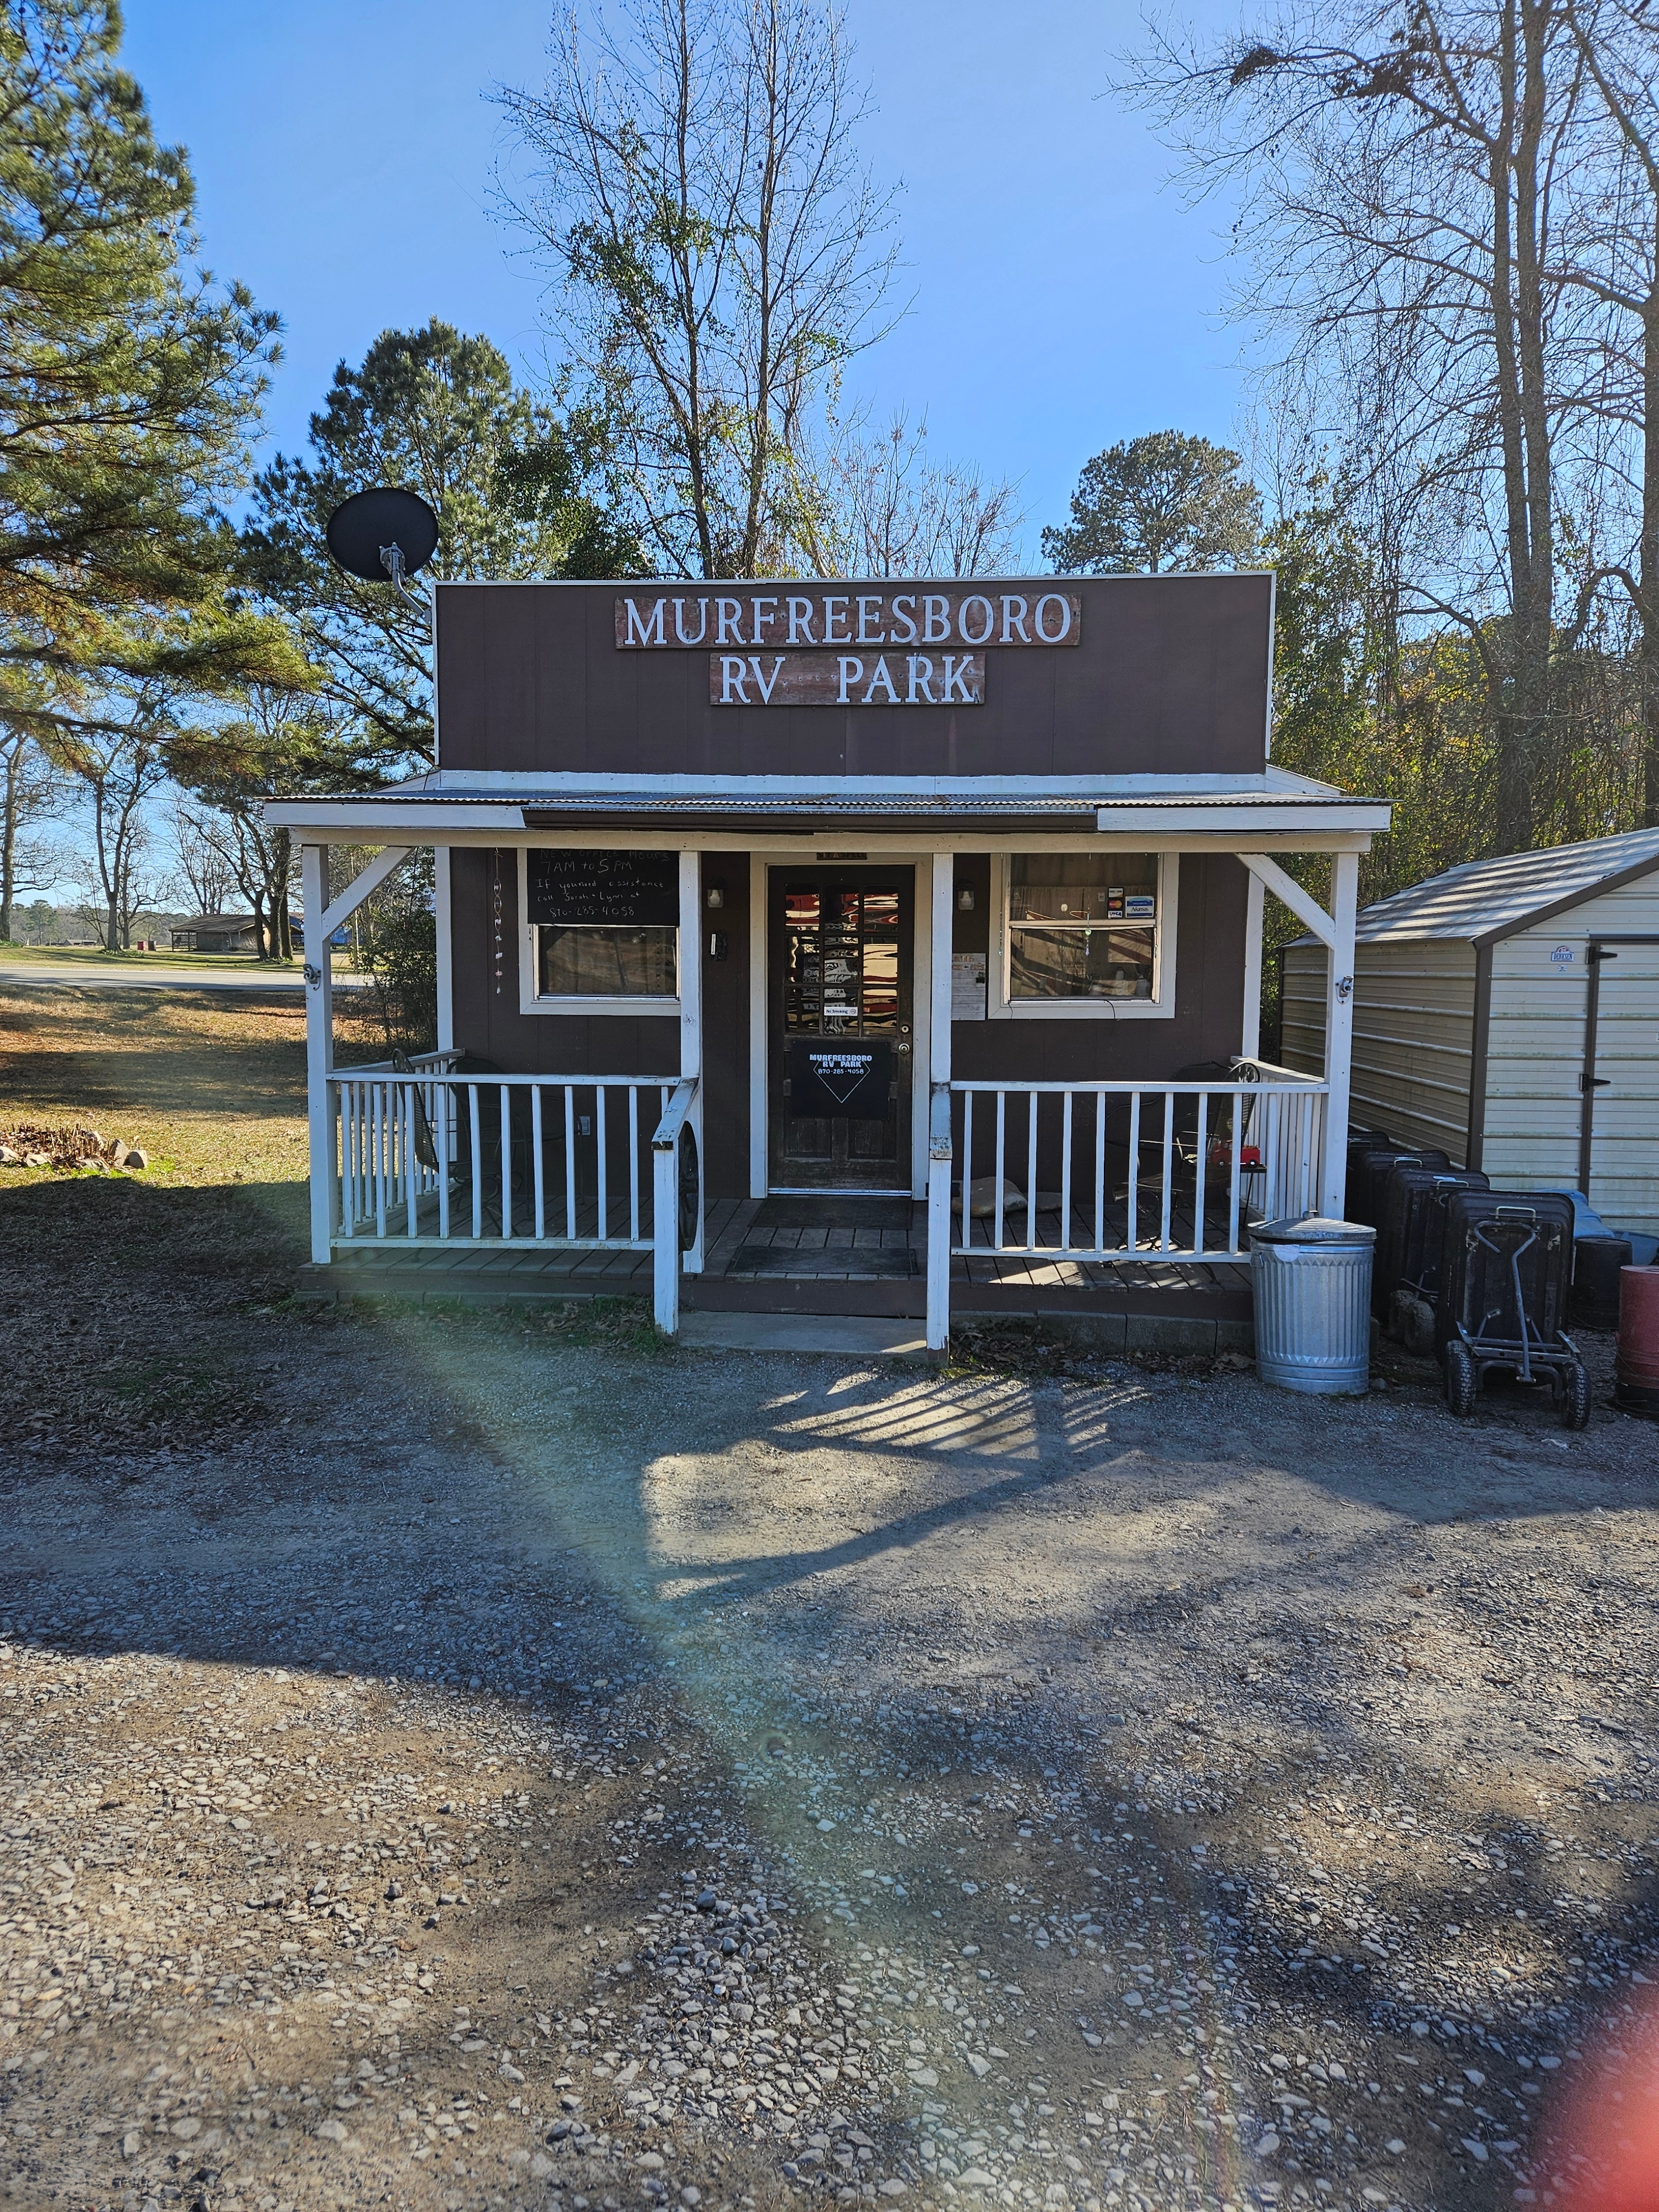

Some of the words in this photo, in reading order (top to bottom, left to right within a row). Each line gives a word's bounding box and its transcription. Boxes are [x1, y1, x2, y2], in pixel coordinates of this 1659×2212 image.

[624, 594, 1071, 647] MURFREESBORO
[719, 656, 786, 705] RV
[837, 654, 975, 703] PARK
[540, 849, 572, 858] NEW
[580, 849, 619, 858] OFFICE
[597, 859, 609, 873] 5
[613, 860, 632, 873] PM
[535, 878, 550, 889] If
